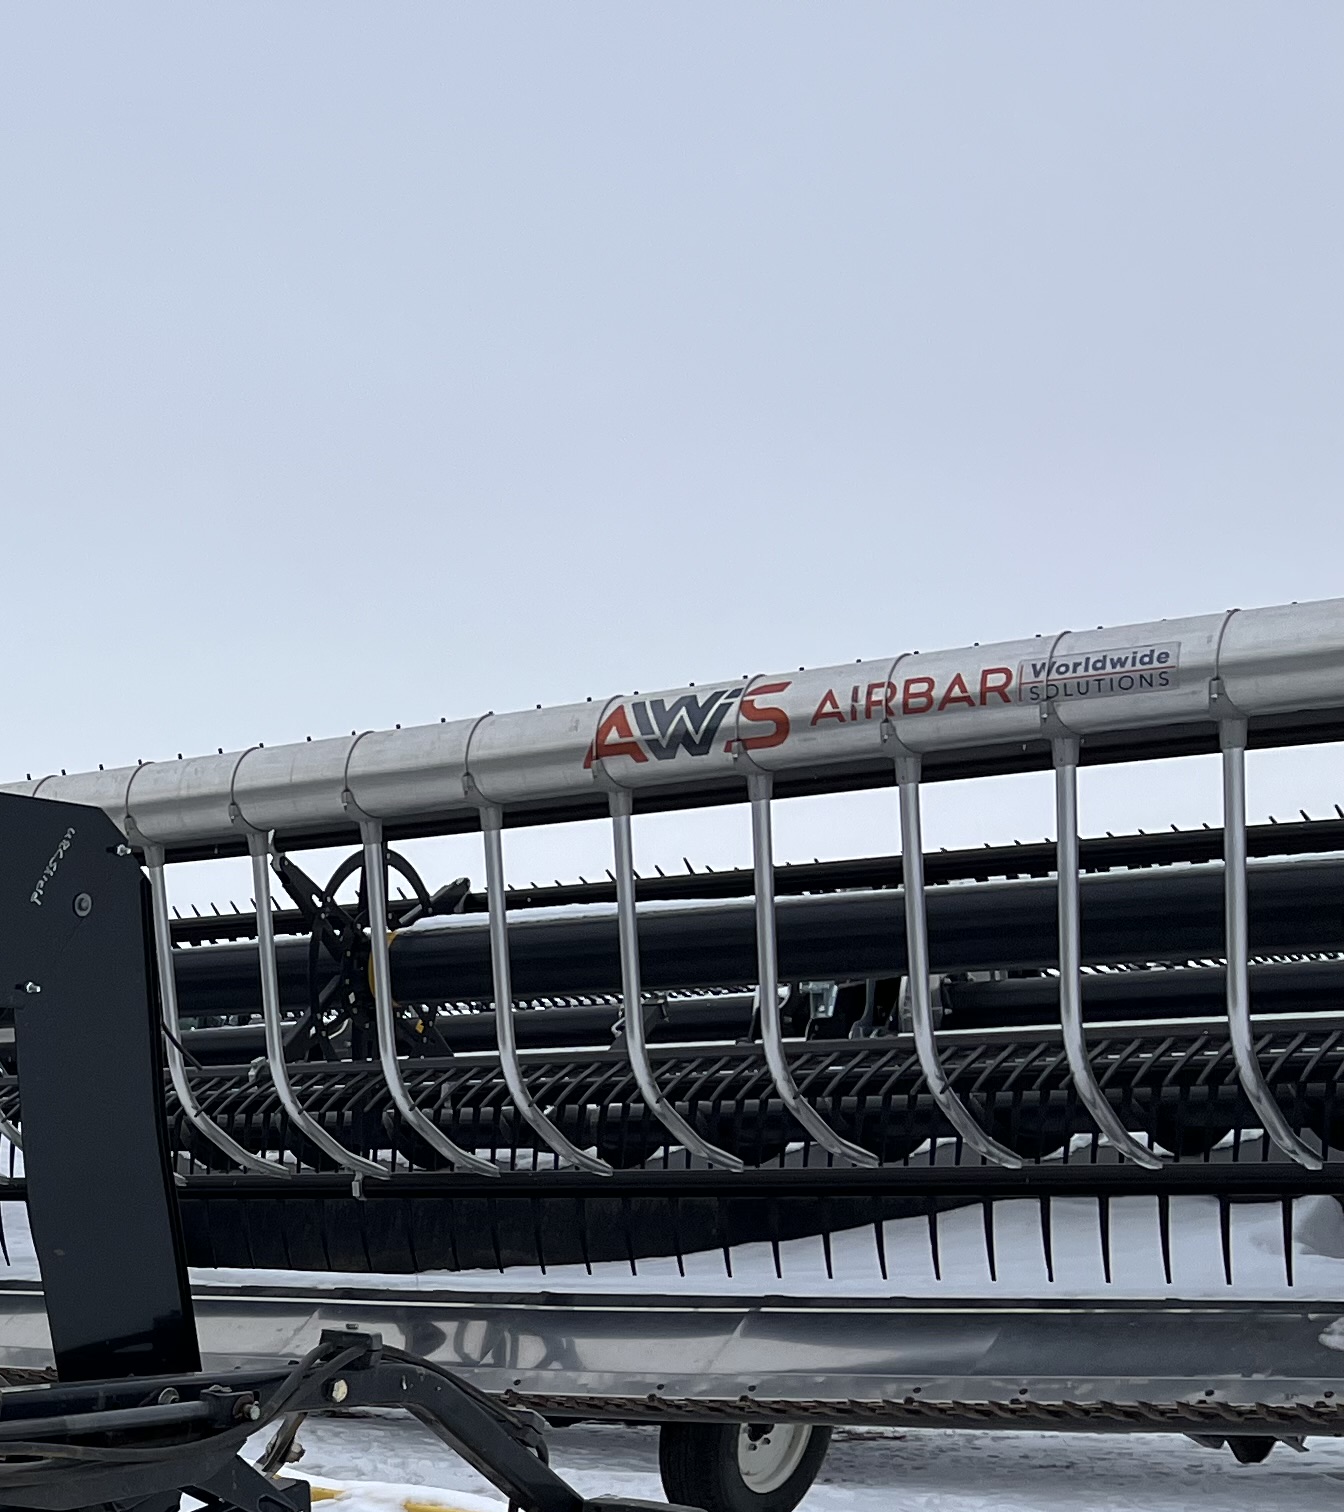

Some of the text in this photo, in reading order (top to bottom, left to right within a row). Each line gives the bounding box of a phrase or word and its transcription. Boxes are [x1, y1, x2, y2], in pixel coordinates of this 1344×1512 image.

[1031, 649, 1170, 679] Worldwide
[1029, 670, 1170, 702] SOLUTIONS
[583, 667, 1014, 769] AWS AIRBAR
